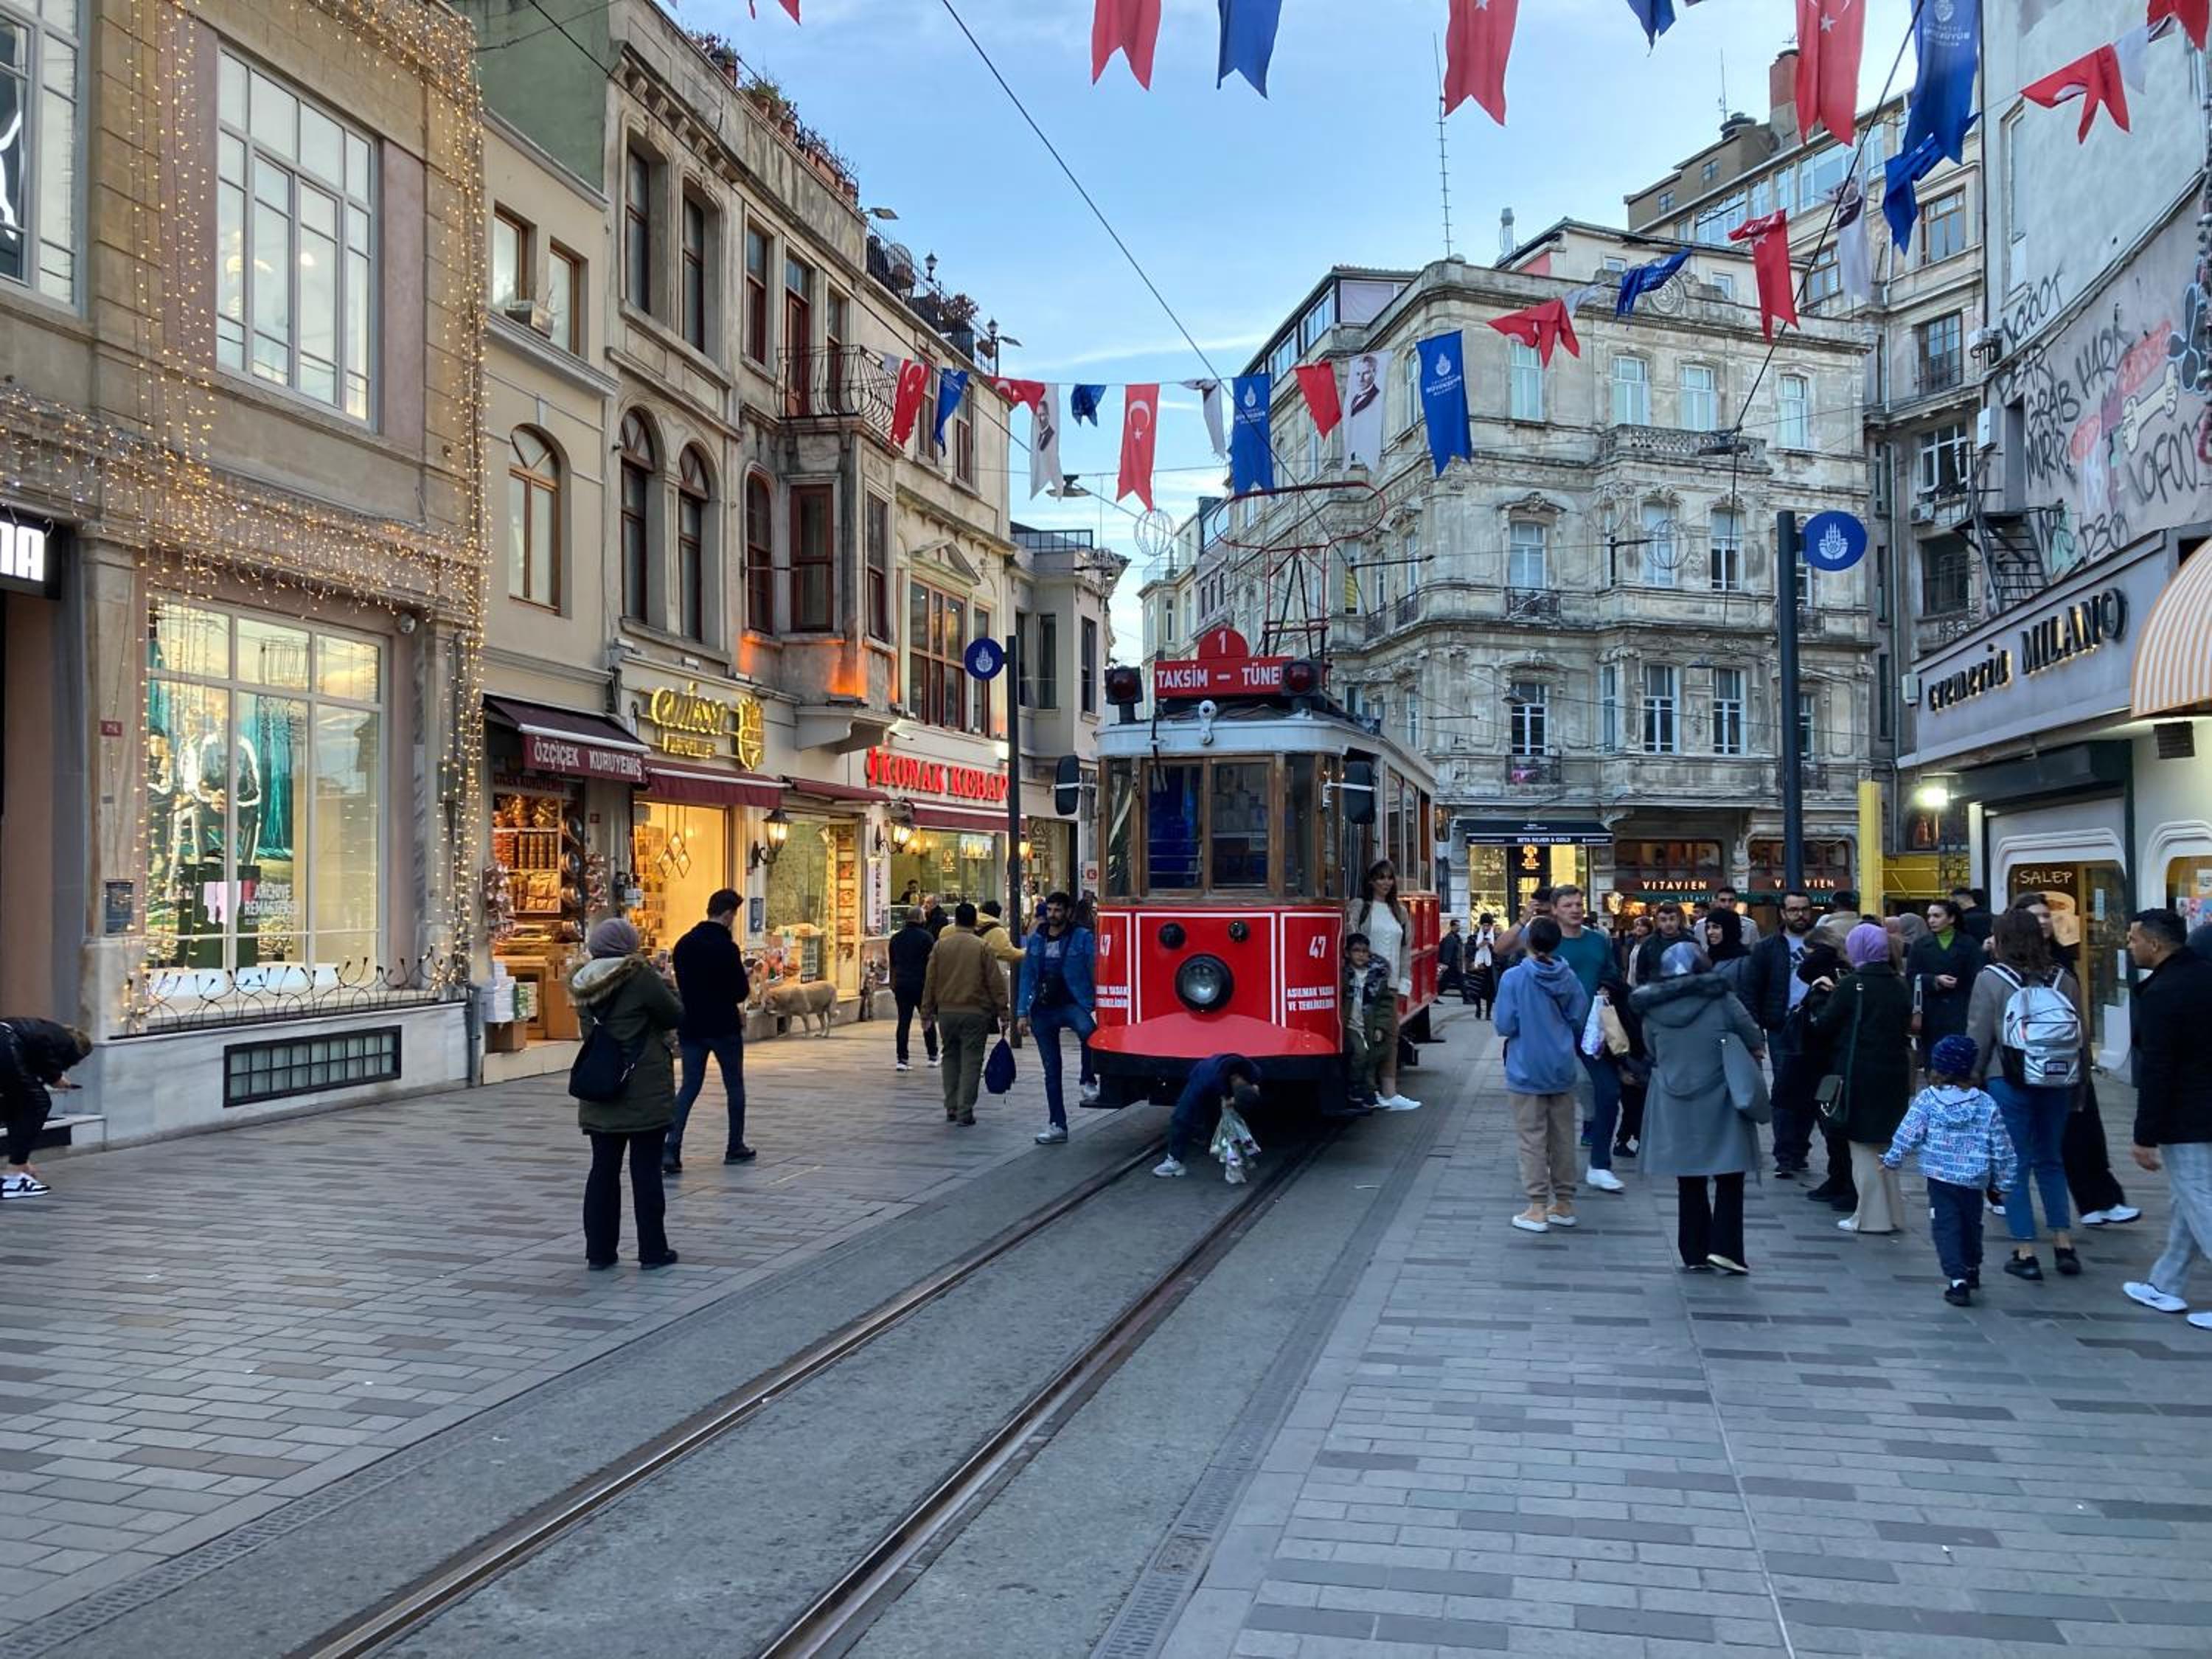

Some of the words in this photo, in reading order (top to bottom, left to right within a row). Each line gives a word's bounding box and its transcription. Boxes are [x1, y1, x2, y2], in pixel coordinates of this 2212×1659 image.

[1218, 630, 1227, 655] 1
[1928, 643, 2011, 712] cremeria
[2020, 588, 2127, 675] MILANO
[1157, 664, 1209, 688] TAKSİM
[533, 737, 580, 772] ÖZÇİÇEK
[588, 750, 642, 782] KURUYEMİŞ
[880, 753, 945, 794] KONAK
[1642, 880, 1708, 890] VITAVIEN
[2019, 870, 2073, 885] SALEP
[1309, 935, 1326, 959] 47
